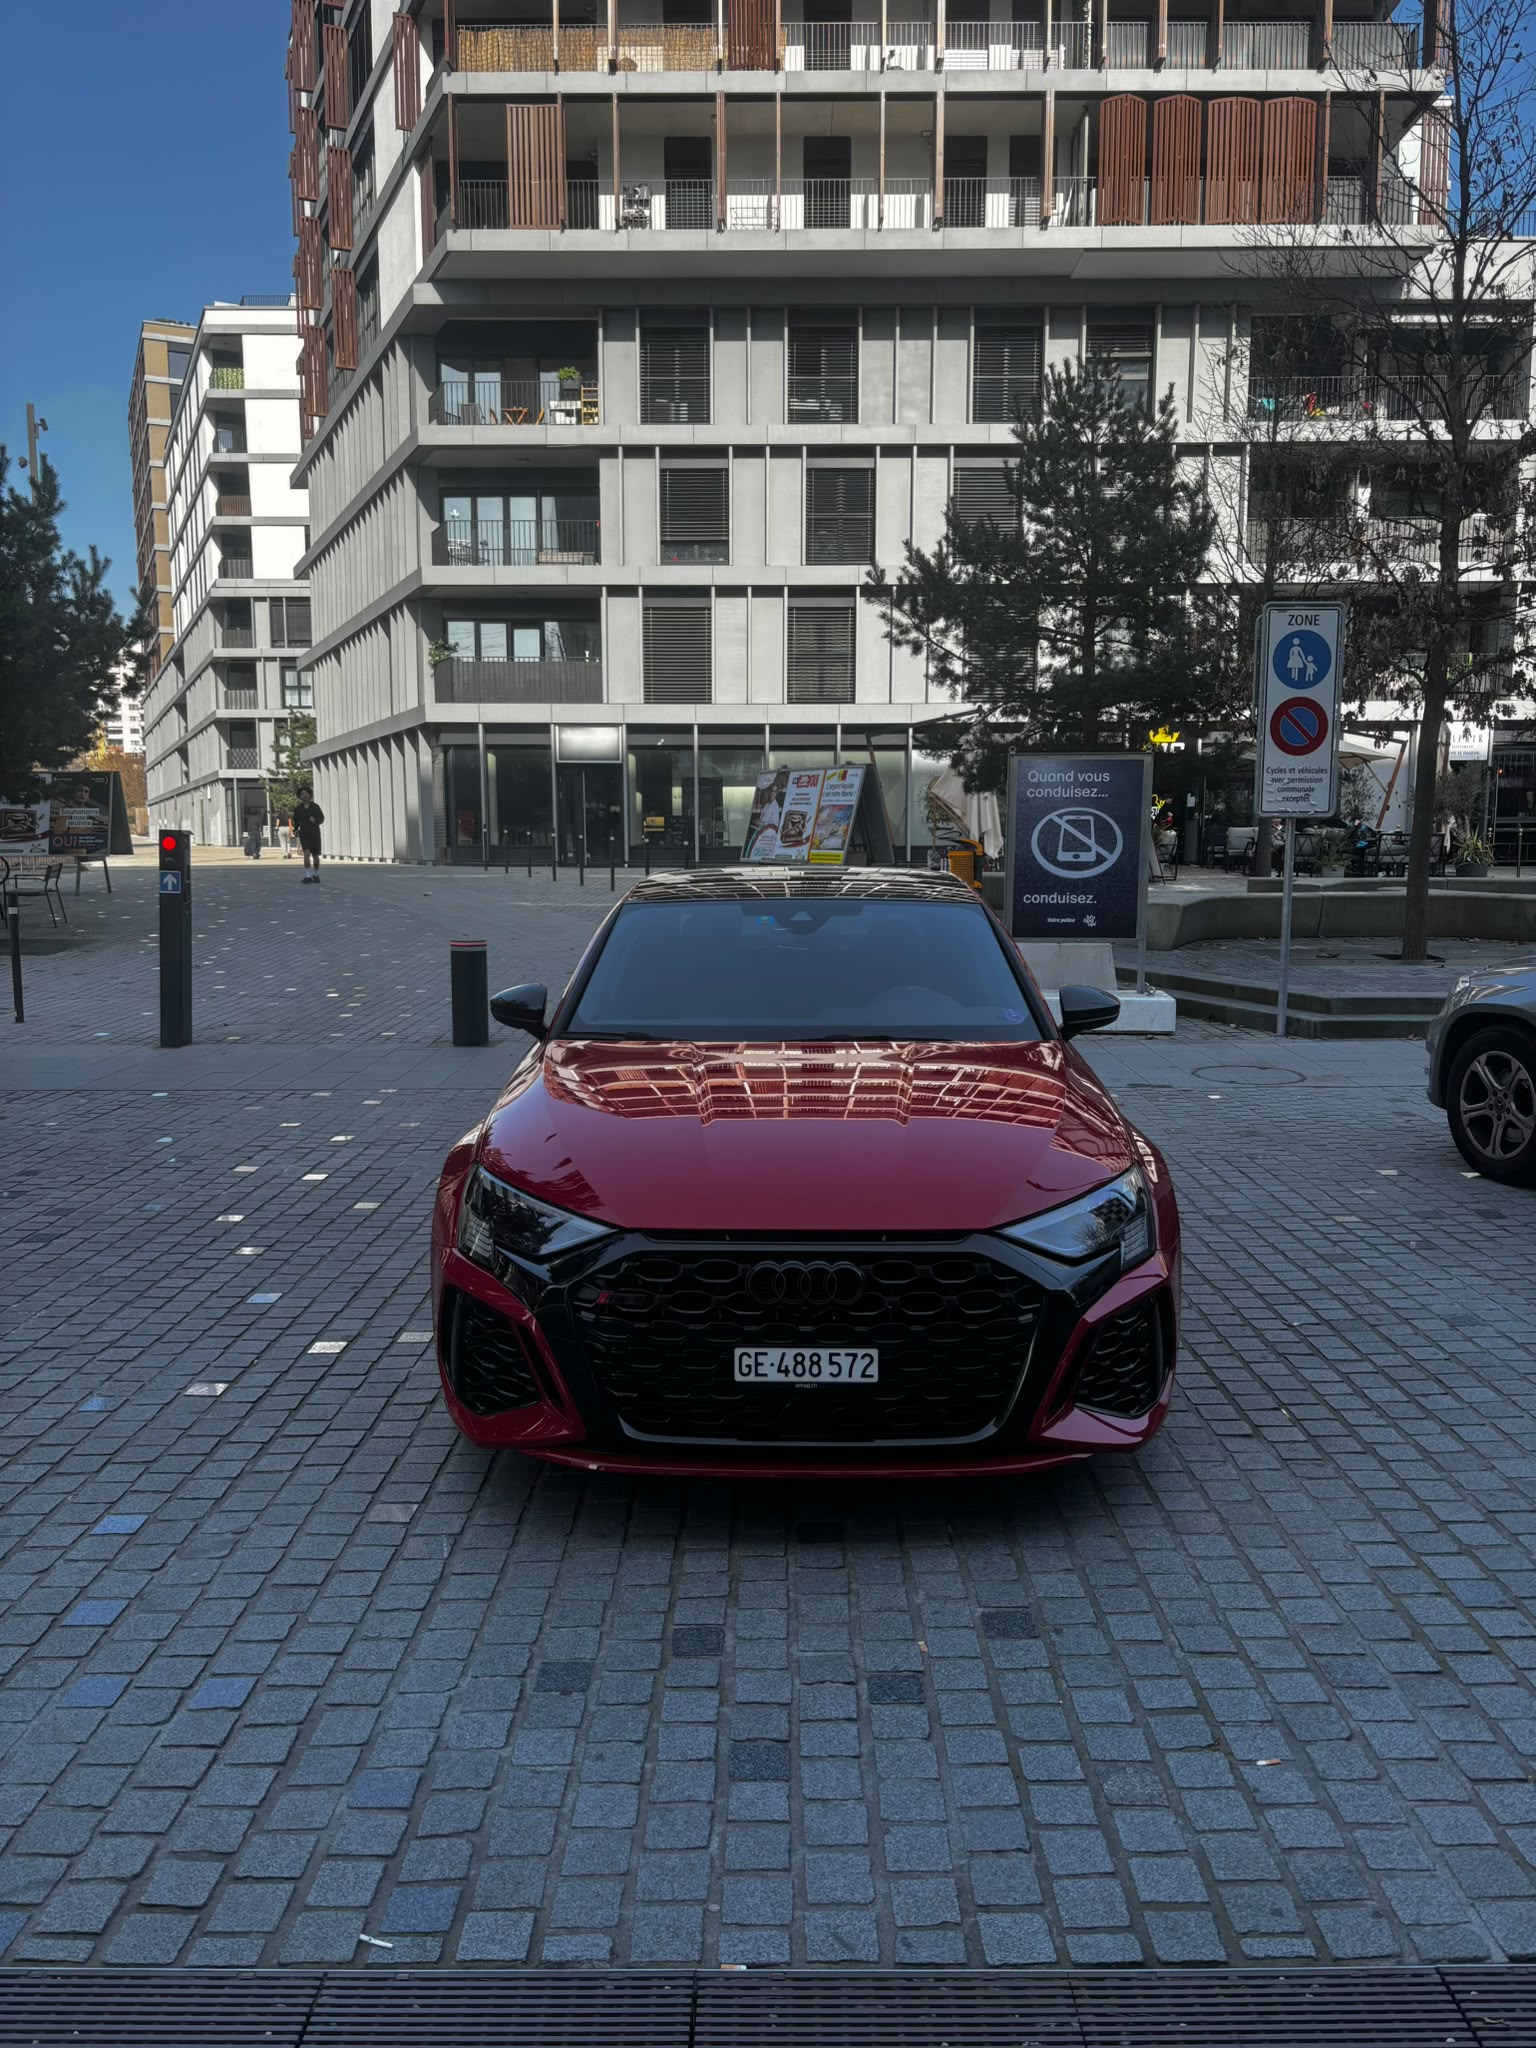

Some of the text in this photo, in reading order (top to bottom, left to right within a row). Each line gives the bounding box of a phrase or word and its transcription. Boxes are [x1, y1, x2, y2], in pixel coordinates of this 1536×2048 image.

[1288, 614, 1321, 626] ZONE
[1028, 770, 1110, 783] Quand vous
[1266, 766, 1287, 776] Cycles
[1298, 766, 1328, 775] véhicules
[1287, 776, 1323, 784] permission
[1027, 786, 1109, 798] conduisez...
[1277, 785, 1316, 793] communale
[53, 836, 77, 847] OUI
[1023, 892, 1097, 904] conduisez.
